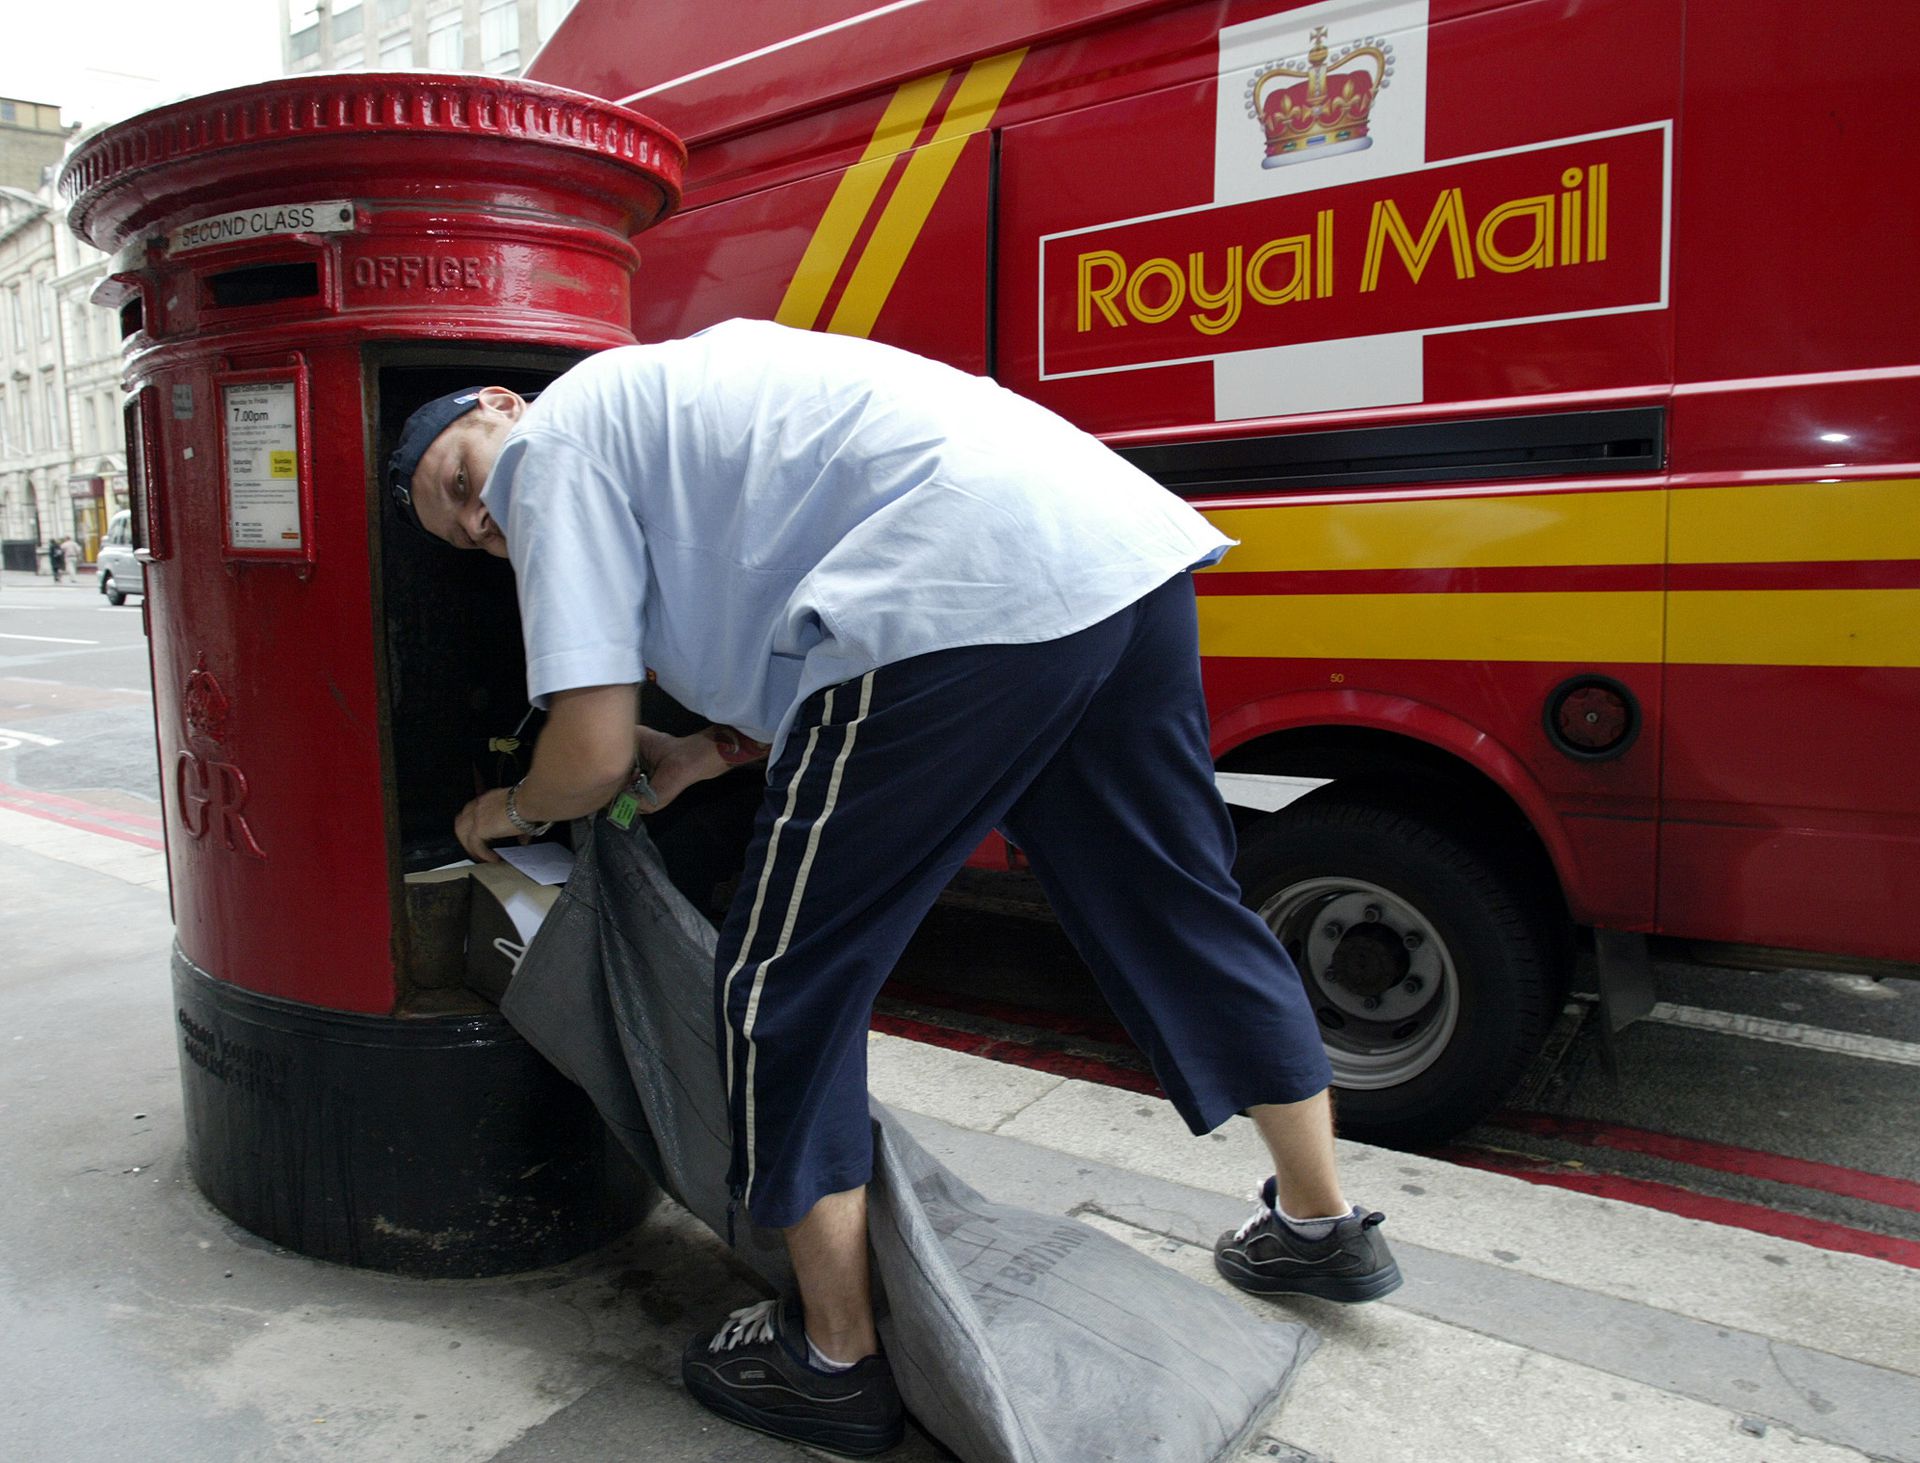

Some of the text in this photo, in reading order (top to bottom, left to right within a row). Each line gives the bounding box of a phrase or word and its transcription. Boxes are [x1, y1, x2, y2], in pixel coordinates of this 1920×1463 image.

[182, 207, 315, 247] SECOND CLASS
[1077, 163, 1609, 336] Royal Mail
[354, 255, 482, 289] OFFICE
[233, 408, 269, 423] 7.00pm
[1330, 672, 1344, 683] 50
